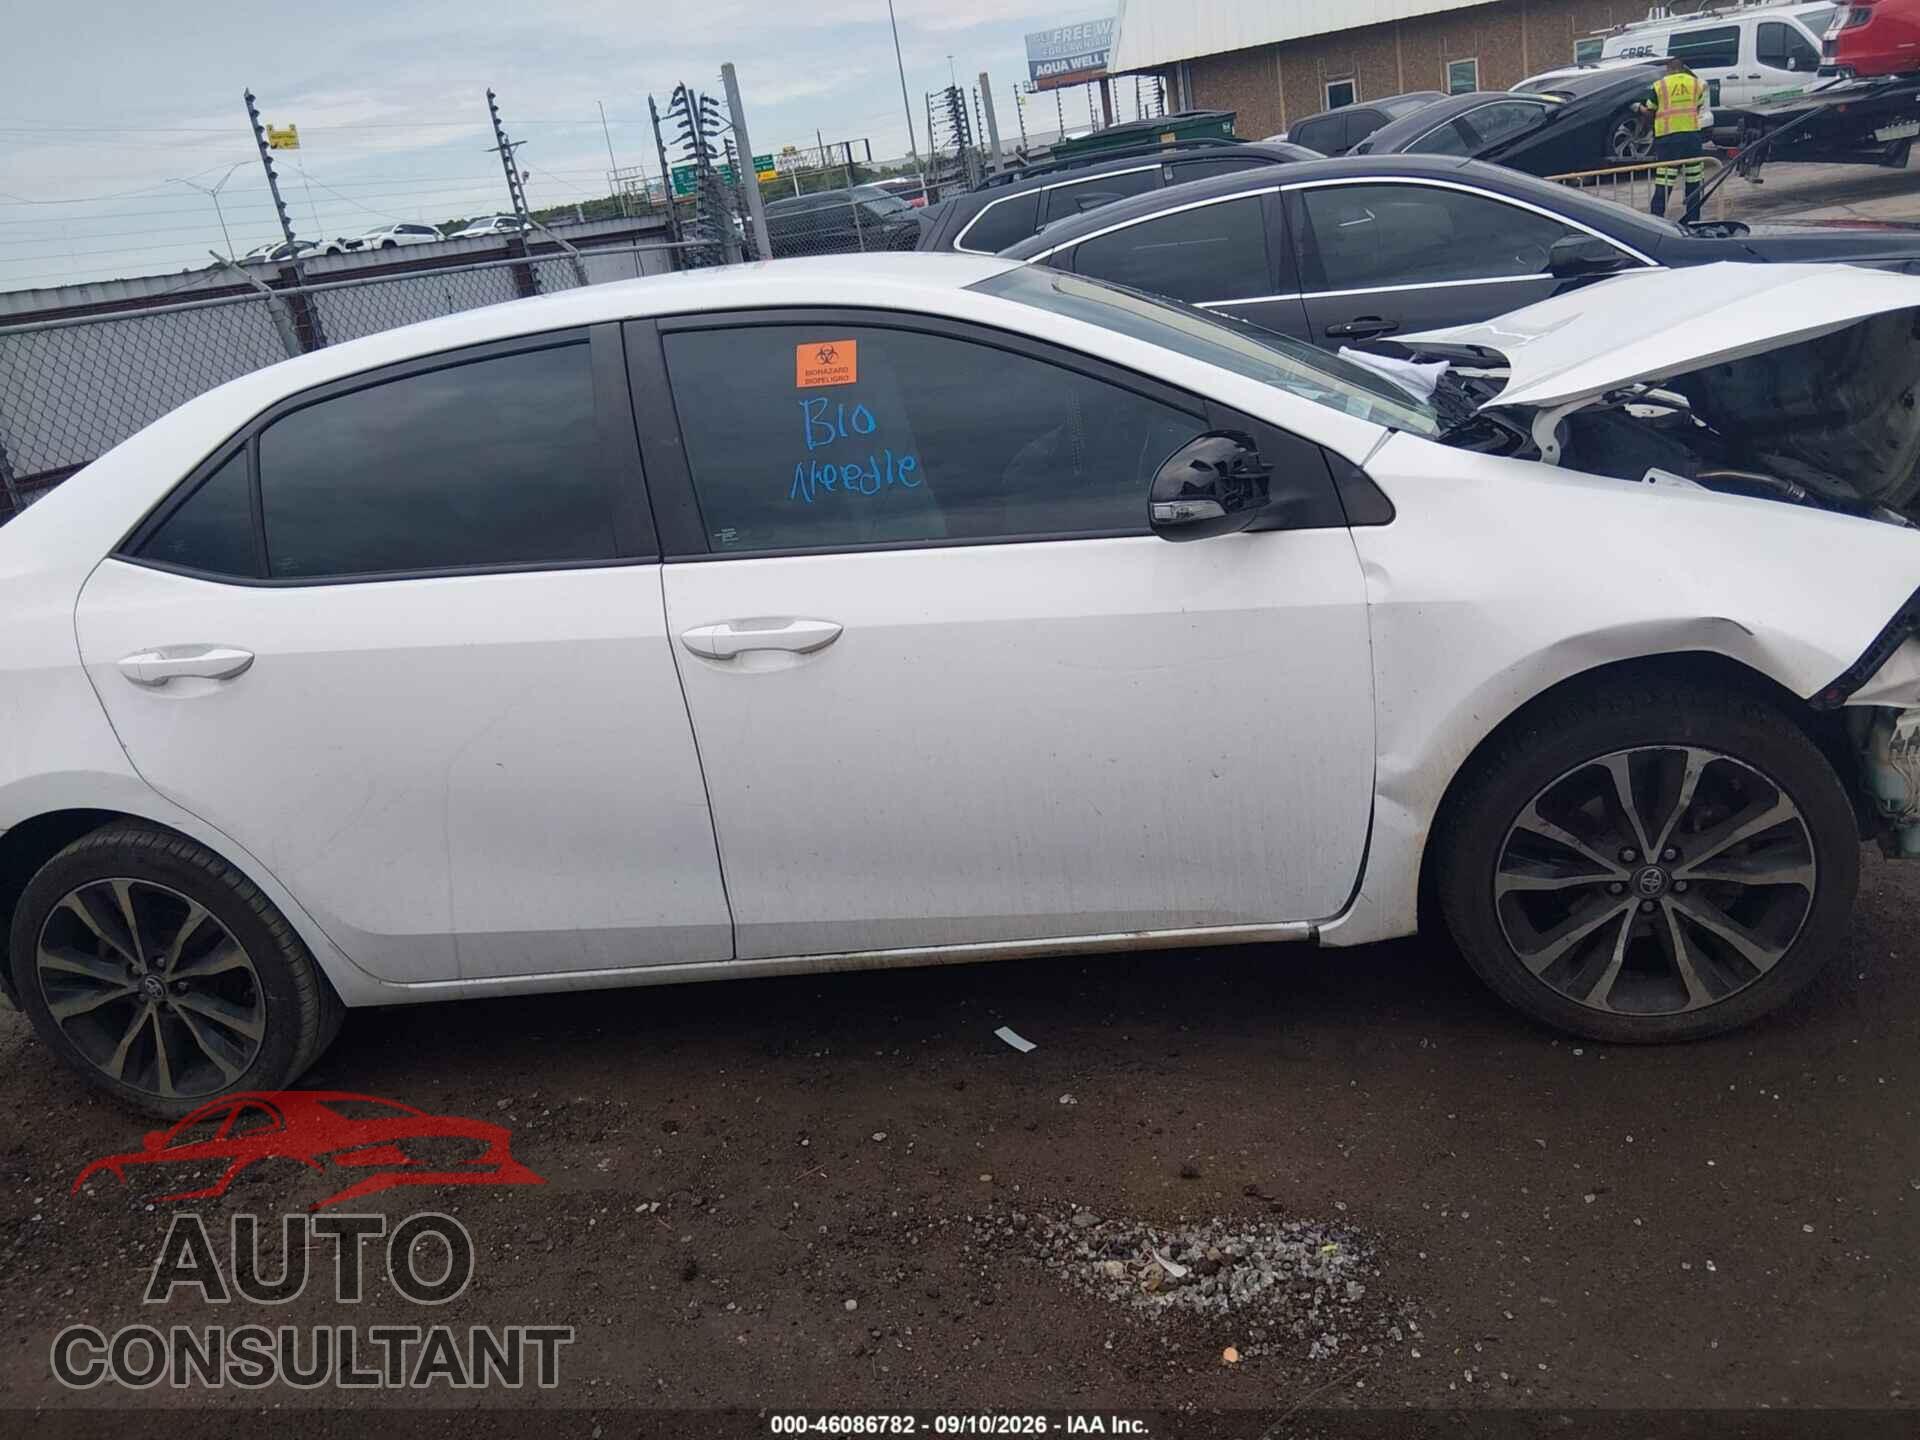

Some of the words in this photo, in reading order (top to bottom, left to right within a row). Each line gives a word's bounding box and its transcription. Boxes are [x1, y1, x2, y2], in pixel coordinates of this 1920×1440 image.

[1054, 24, 1091, 43] FREE
[1036, 60, 1070, 76] AQUA
[1069, 54, 1102, 69] WELL
[805, 366, 848, 377] BIOHAZARD
[805, 375, 849, 385] BIOPELIGRO
[791, 448, 921, 503] Needle
